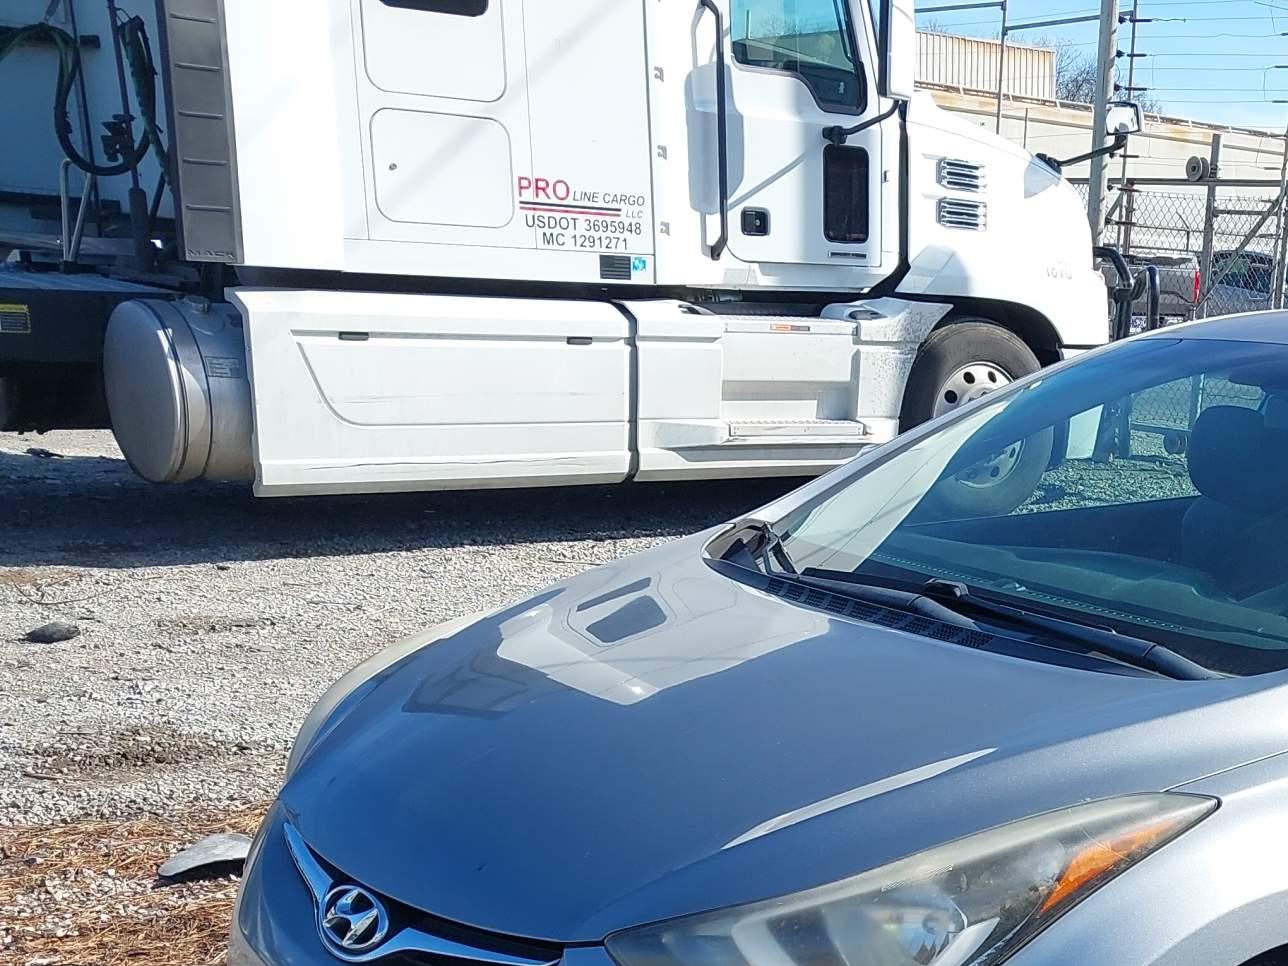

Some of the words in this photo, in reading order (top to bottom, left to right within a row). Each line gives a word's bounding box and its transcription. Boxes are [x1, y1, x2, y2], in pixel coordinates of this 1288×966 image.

[518, 176, 570, 201] PRO
[573, 191, 599, 204] LINE
[603, 193, 645, 207] CARGO
[626, 210, 644, 219] LLC
[525, 214, 579, 231] USDOT
[584, 218, 642, 235] 3695948
[542, 232, 566, 246] MC
[571, 234, 628, 250] 1291271
